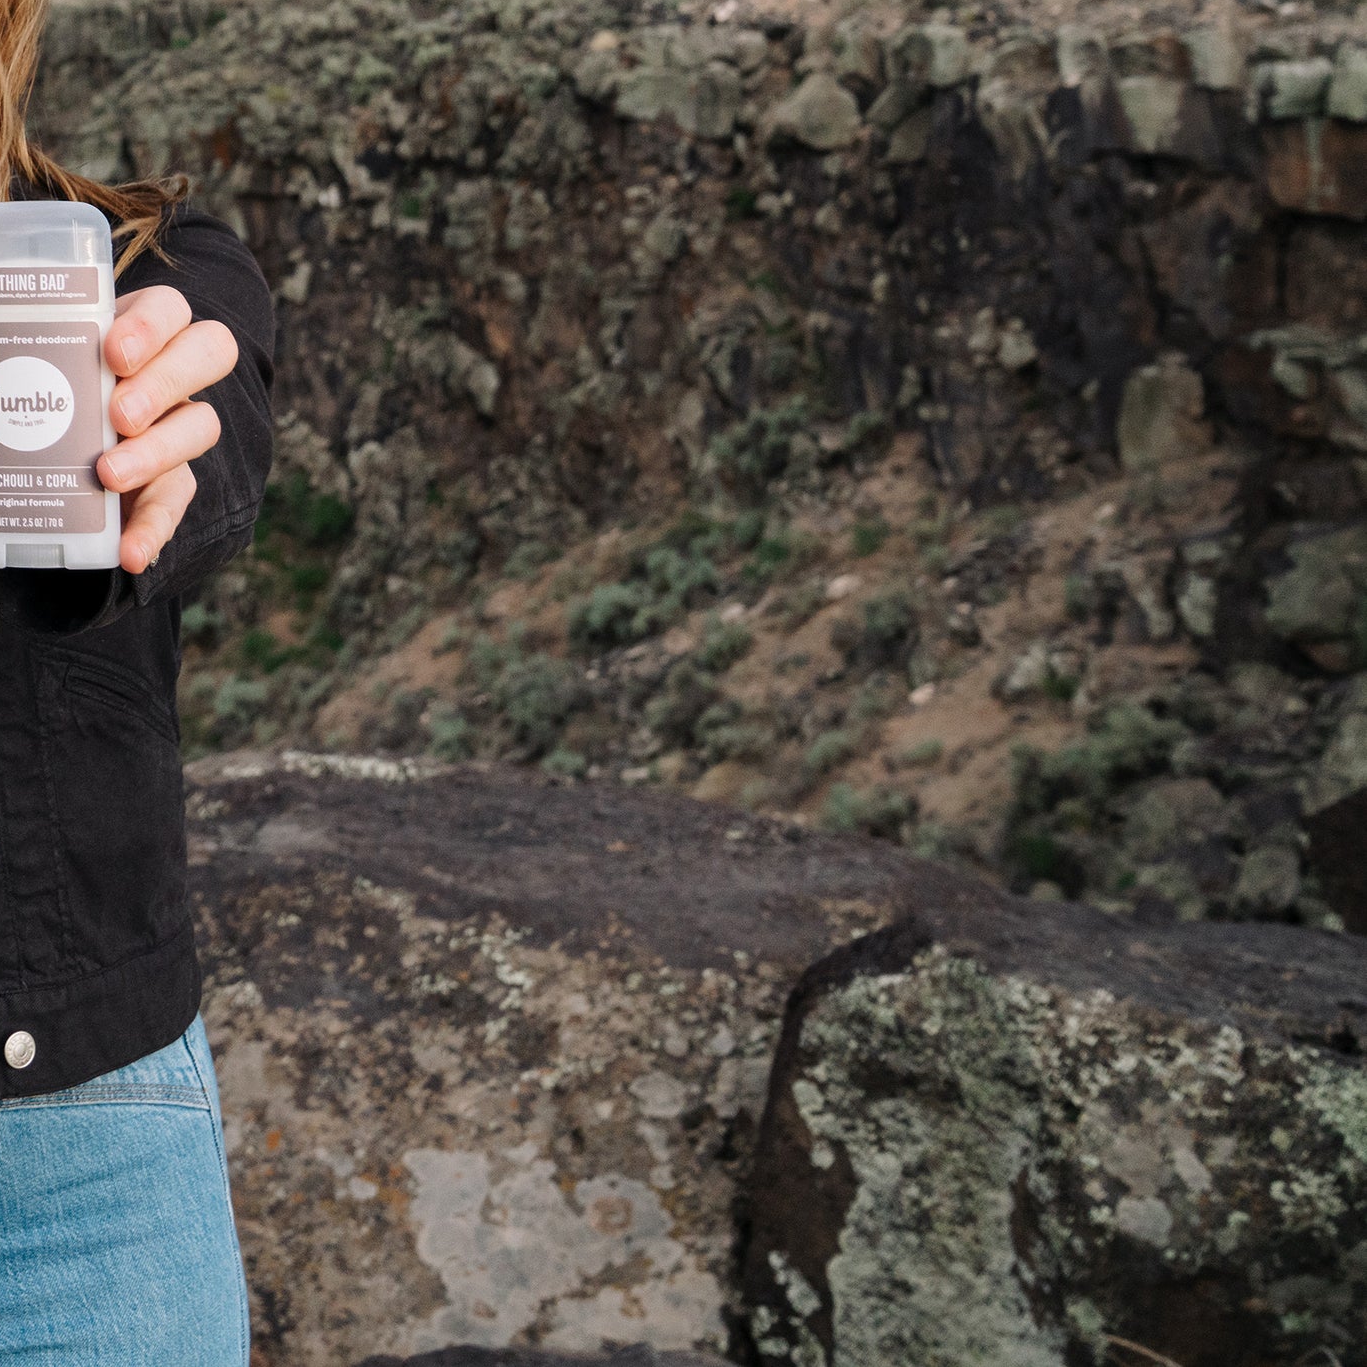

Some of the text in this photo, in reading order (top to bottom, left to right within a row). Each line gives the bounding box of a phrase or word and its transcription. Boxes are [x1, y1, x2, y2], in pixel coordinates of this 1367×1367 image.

[35, 335, 87, 344] deodorant
[36, 476, 43, 487] &
[46, 474, 78, 488] COPAL
[28, 498, 65, 507] formula
[9, 518, 21, 527] WT.
[22, 518, 33, 527] 2.5
[34, 518, 43, 527] OZ
[48, 518, 58, 527] 70
[58, 518, 64, 527] G
